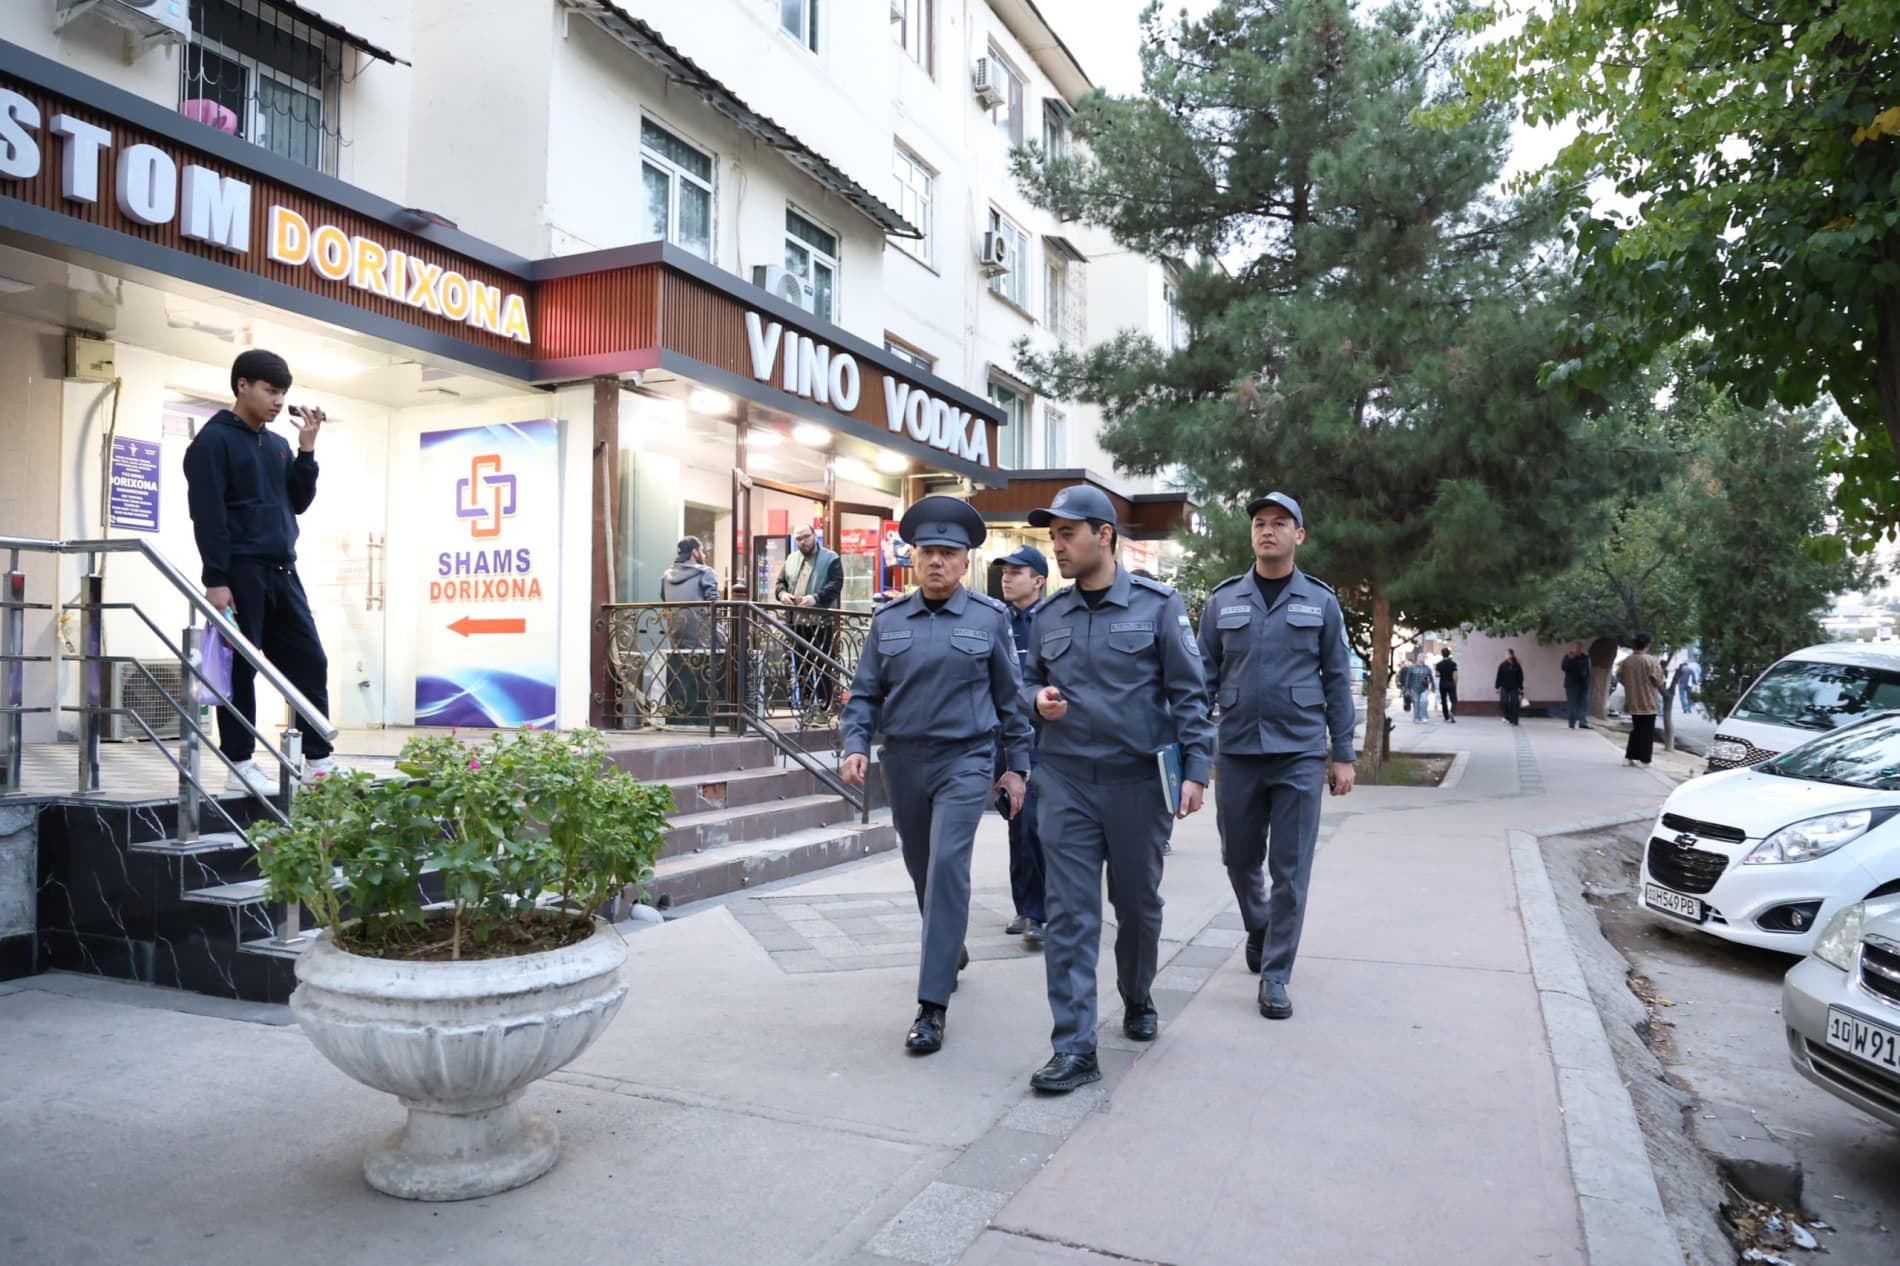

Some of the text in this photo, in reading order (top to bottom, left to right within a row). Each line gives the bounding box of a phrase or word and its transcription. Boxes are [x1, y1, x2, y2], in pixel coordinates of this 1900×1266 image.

[0, 87, 531, 344] STOM DORIXONA
[745, 311, 990, 467] VINO VODKA
[112, 475, 158, 491] ORIXONA
[438, 548, 531, 576] SHAMS
[430, 577, 542, 601] DORIXONA
[1831, 1018, 1900, 1068] 10 W91
